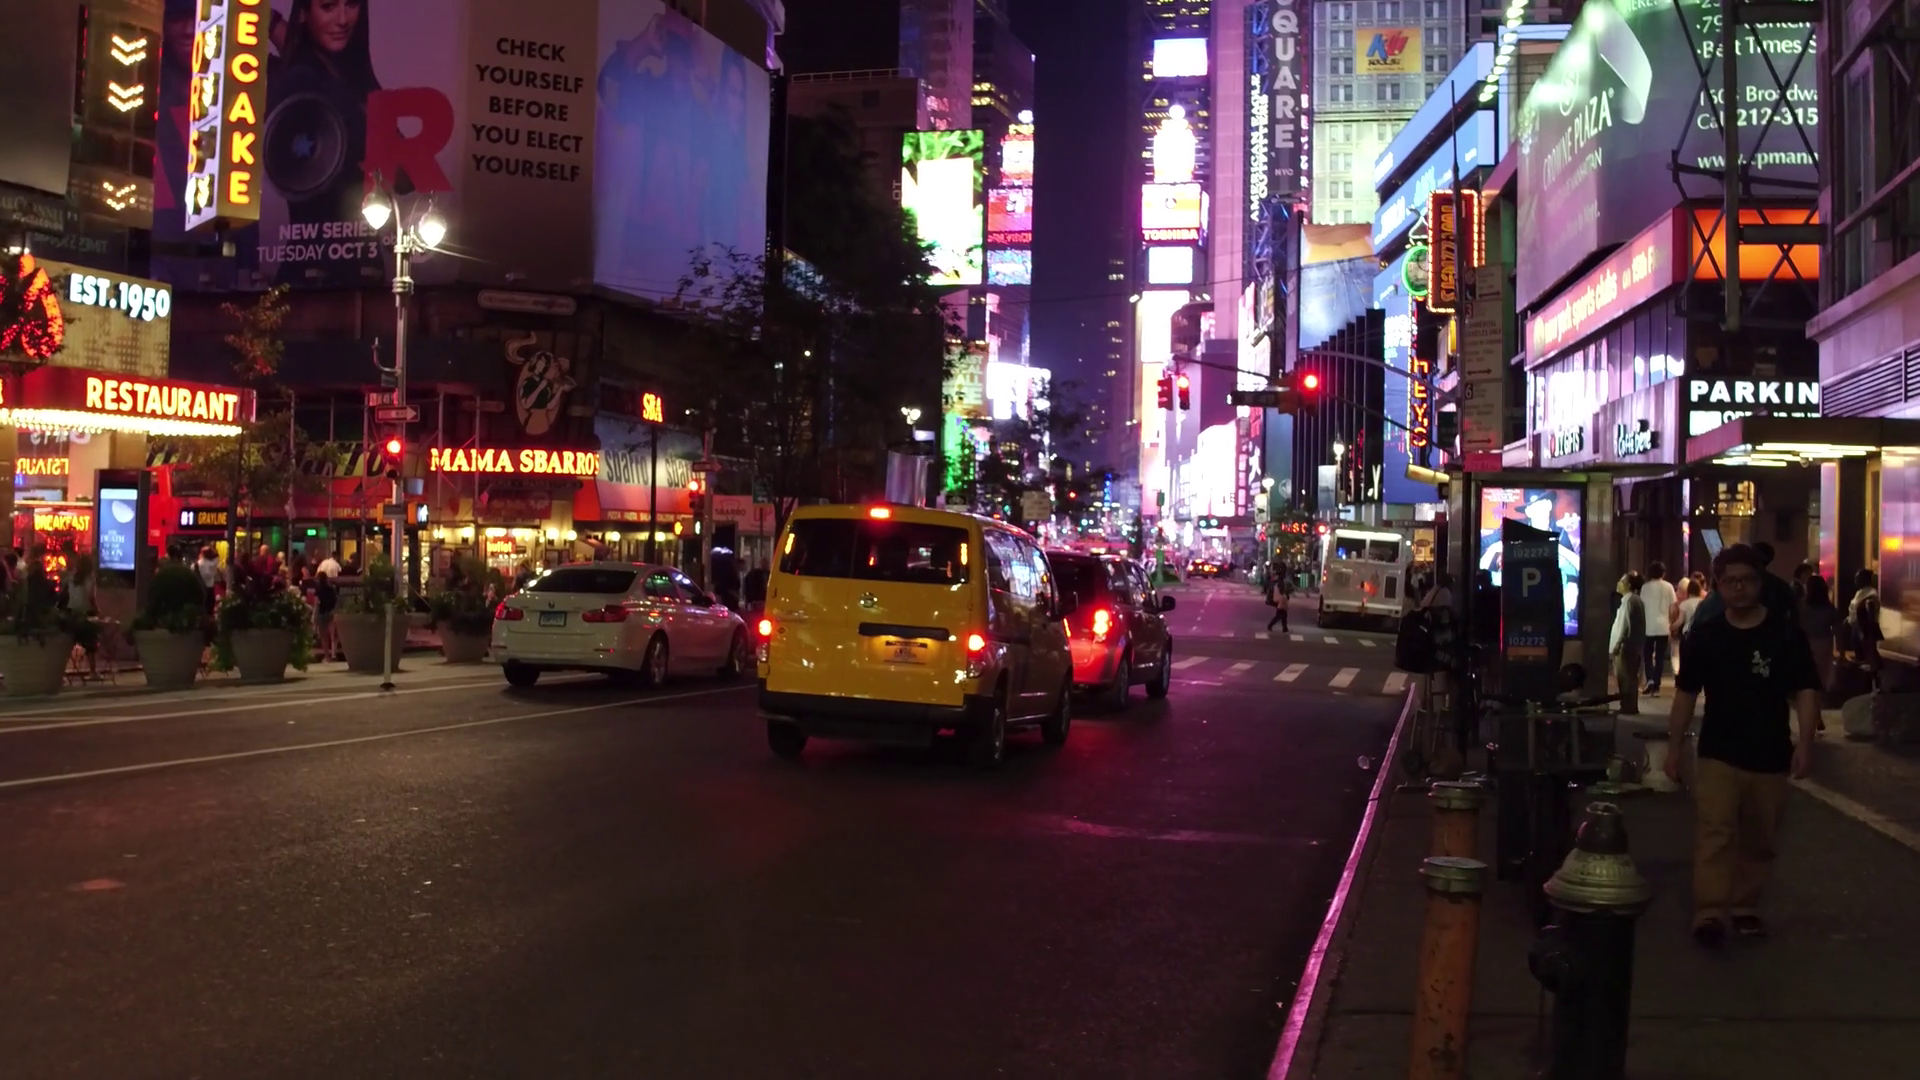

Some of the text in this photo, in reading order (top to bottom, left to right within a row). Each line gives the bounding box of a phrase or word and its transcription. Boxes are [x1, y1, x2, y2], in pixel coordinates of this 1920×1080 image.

[496, 37, 566, 62] CHECK
[475, 64, 584, 94] YOURSELF
[1272, 0, 1299, 149] QUARE
[228, 0, 260, 204] ECAKE
[489, 96, 569, 122] BEFORE
[1574, 90, 1612, 154] PLAZA
[472, 124, 583, 153] YOU ELECT
[472, 154, 580, 182] YOURSELF
[1274, 168, 1294, 177] NYC
[278, 222, 319, 241] NEW
[1142, 229, 1199, 241] TOSHIBA
[256, 242, 378, 263] TUESDAY OCT 3
[70, 273, 171, 321] EST.1950
[86, 376, 238, 422] RESTAURANT
[1465, 383, 1473, 399] 6
[1690, 380, 1819, 404] PARKIN
[430, 448, 514, 472] MAMA
[604, 449, 650, 486] sbarro
[34, 514, 90, 531] BREAKFAST
[487, 540, 512, 553] buffet
[1522, 566, 1542, 598] P
[1509, 636, 1547, 647] 102272
